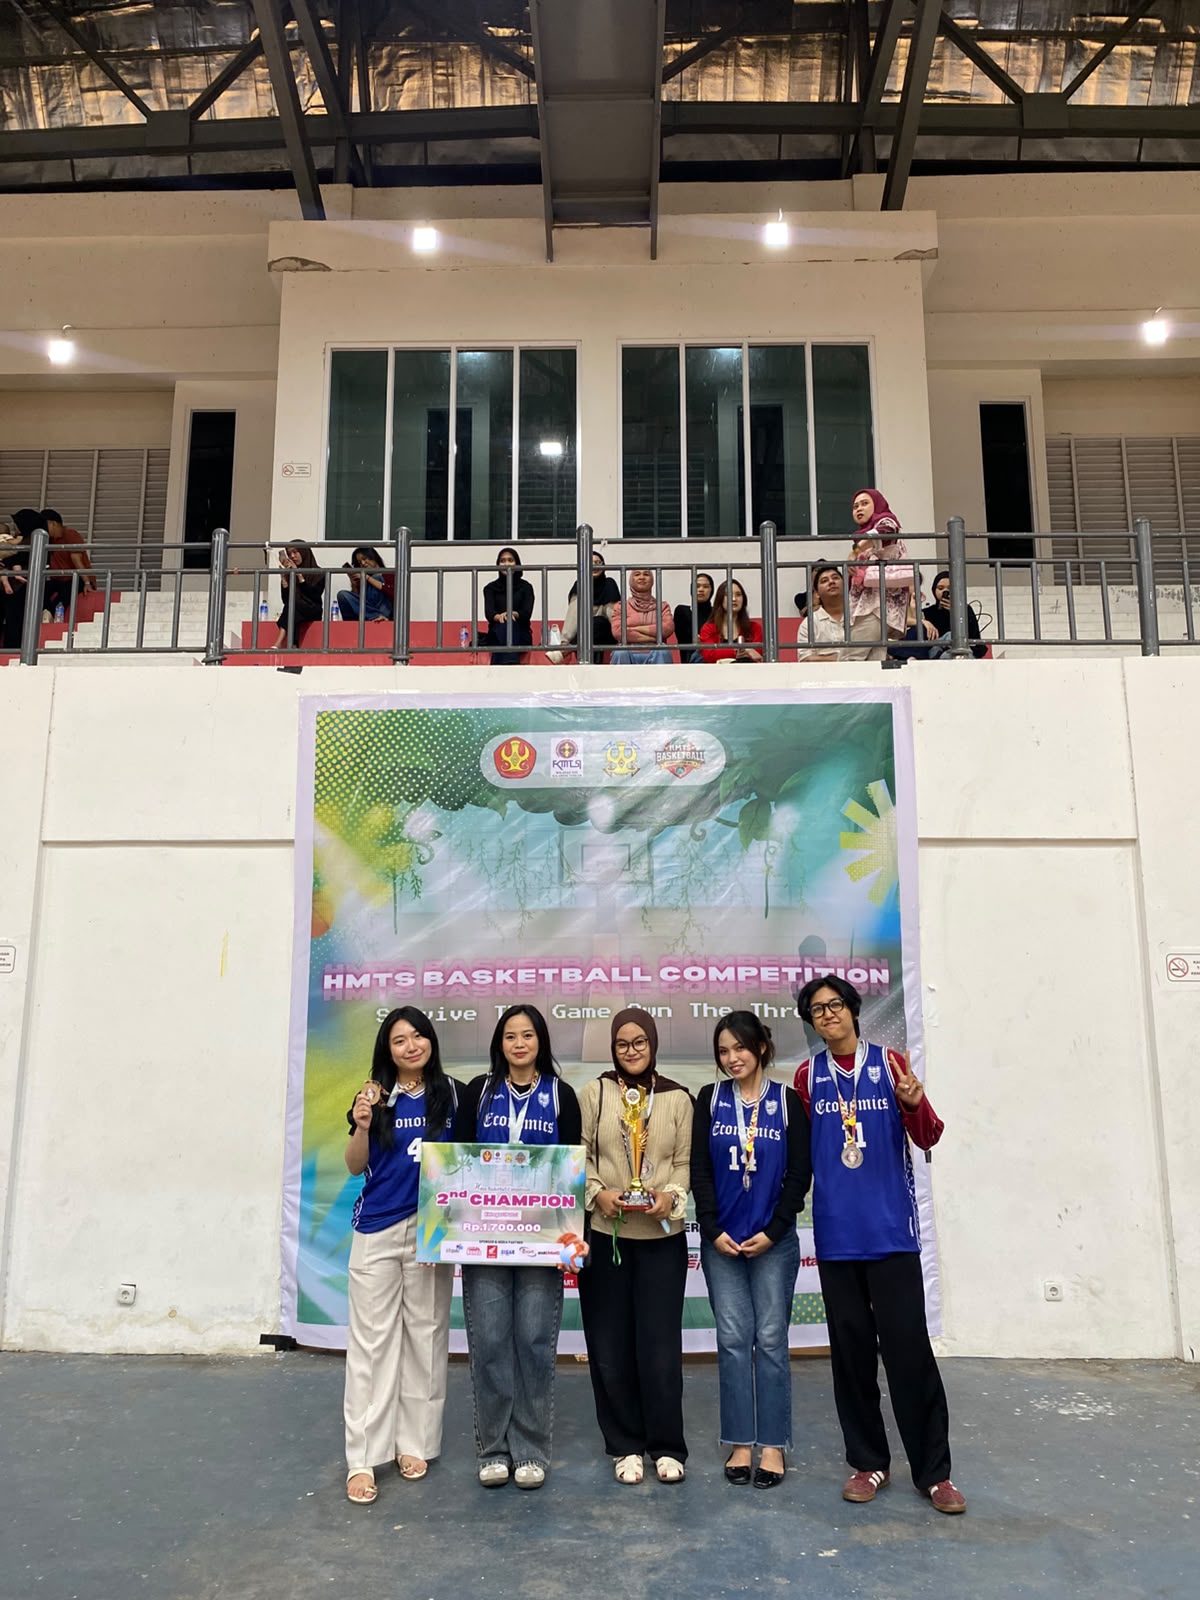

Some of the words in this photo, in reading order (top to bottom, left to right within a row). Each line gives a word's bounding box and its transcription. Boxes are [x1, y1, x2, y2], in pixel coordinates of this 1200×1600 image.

[656, 751, 705, 762] BASKETBALL
[323, 972, 416, 989] HMTS
[423, 966, 652, 986] BASKETBALL
[659, 966, 890, 984] COMPETITION
[376, 1006, 477, 1023] Svive
[552, 1004, 611, 1019] Game
[689, 1003, 733, 1018] The
[750, 1002, 801, 1018] Thr
[815, 1095, 889, 1115] Ecomics
[483, 1112, 554, 1134] Ecomics
[436, 1190, 468, 1205] 2nd
[469, 1194, 576, 1208] CHAMPION
[463, 1222, 541, 1233] Rp.1.700.000
